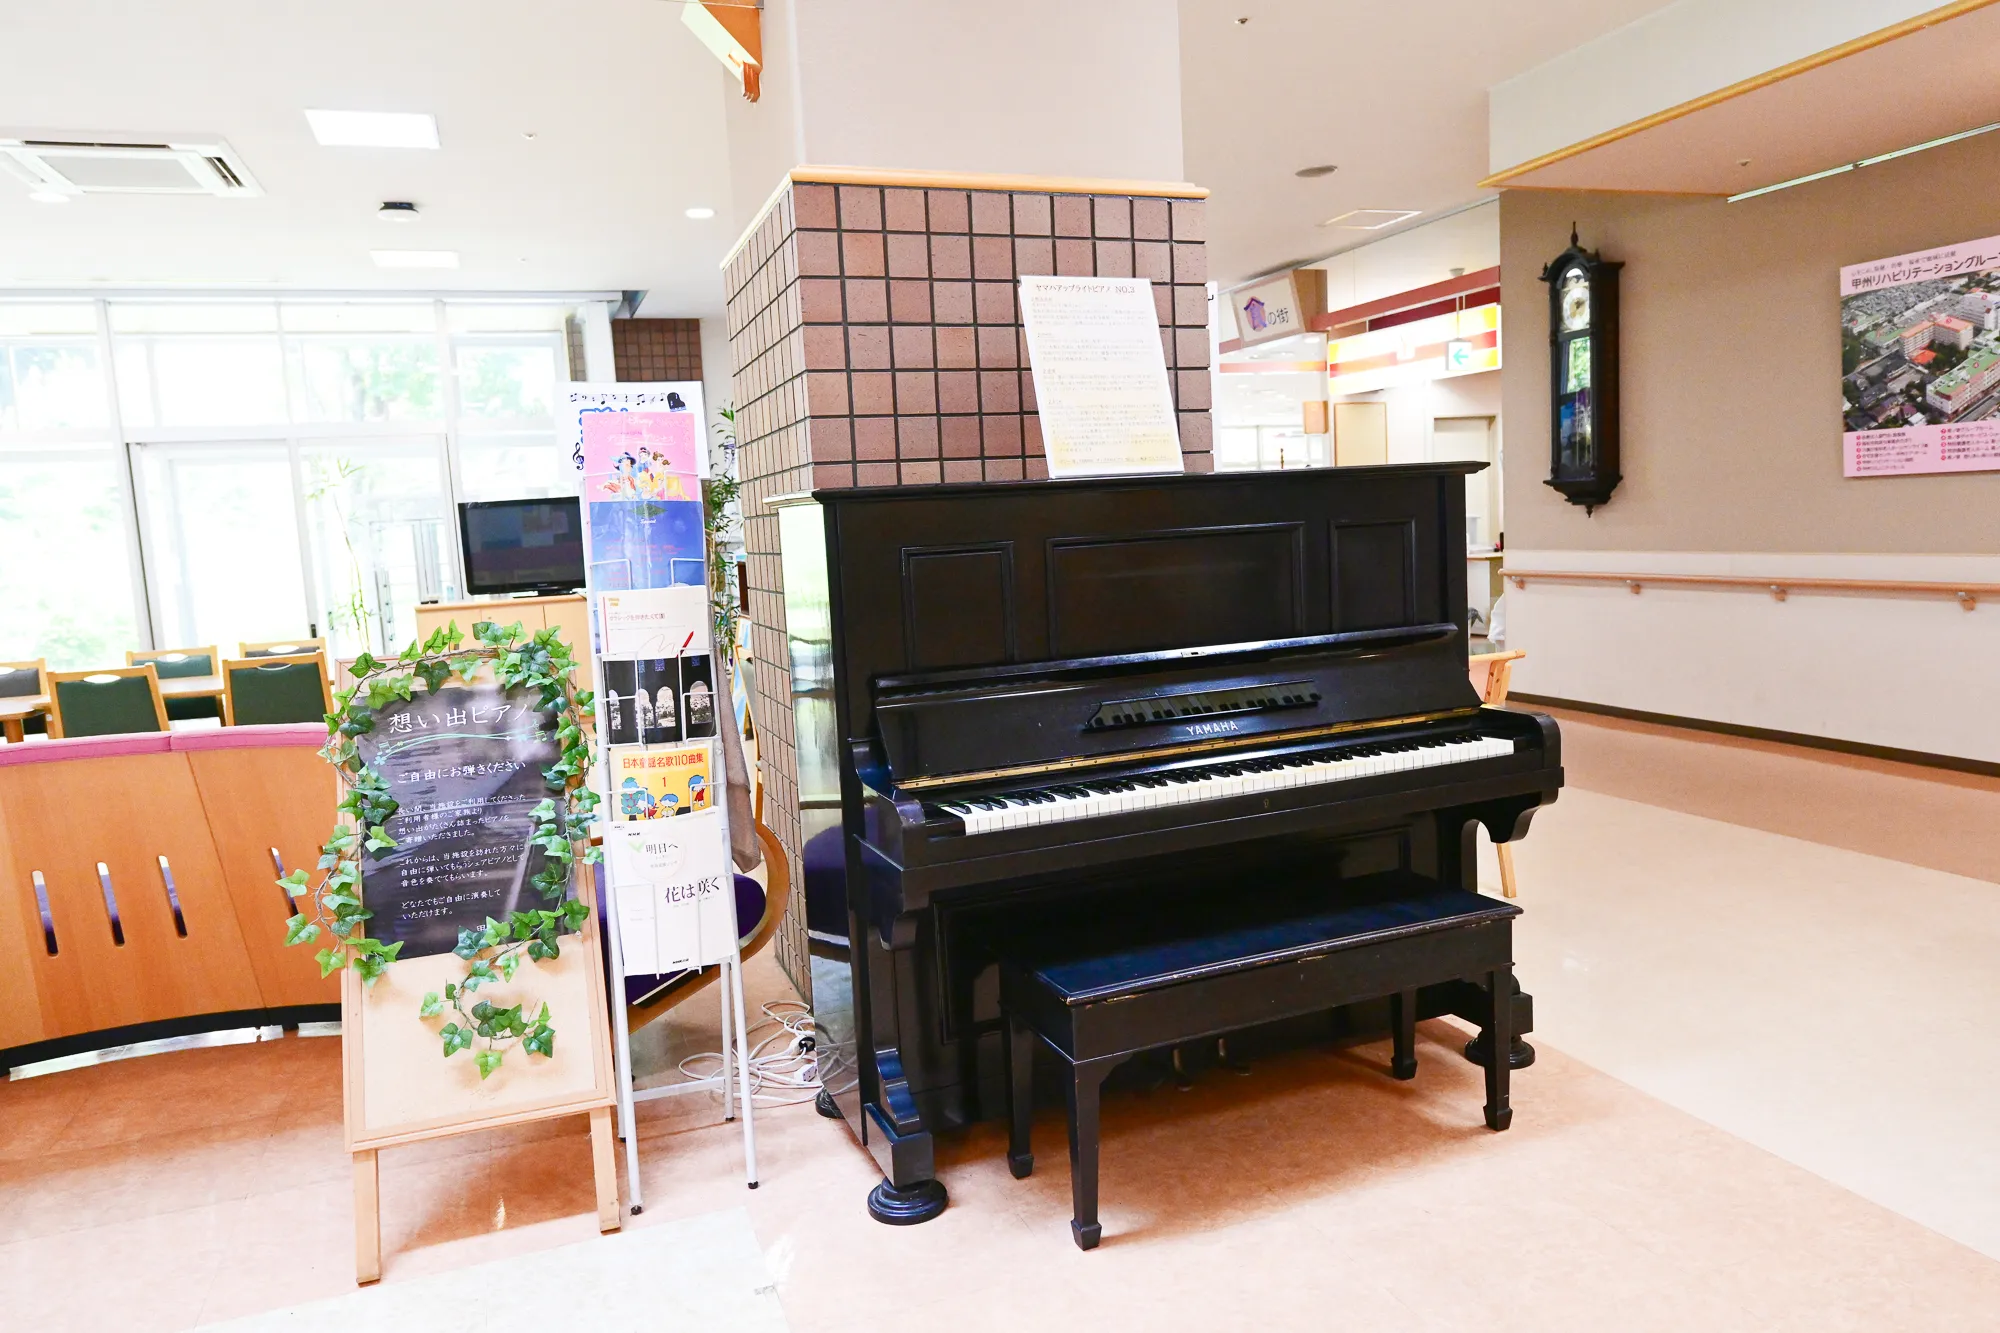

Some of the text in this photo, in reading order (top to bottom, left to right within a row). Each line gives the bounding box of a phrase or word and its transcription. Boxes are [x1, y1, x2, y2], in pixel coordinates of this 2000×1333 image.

[1851, 251, 2000, 289] 甲州リハビリテーショングルー
[389, 704, 528, 734] 想い出ピアノ
[1186, 720, 1239, 736] YAMAHA
[397, 760, 526, 784] ご自由にお弾きください
[623, 753, 704, 769] 日本童謡名歌110曲集
[662, 776, 667, 787] 1
[400, 844, 524, 866] これからは、当施設を訪れた方々に
[645, 842, 679, 854] 明日へ
[401, 888, 501, 910] どなたでもご自由に演奏して
[665, 877, 720, 903] 花は咲く
[402, 907, 453, 920] いただけます。
